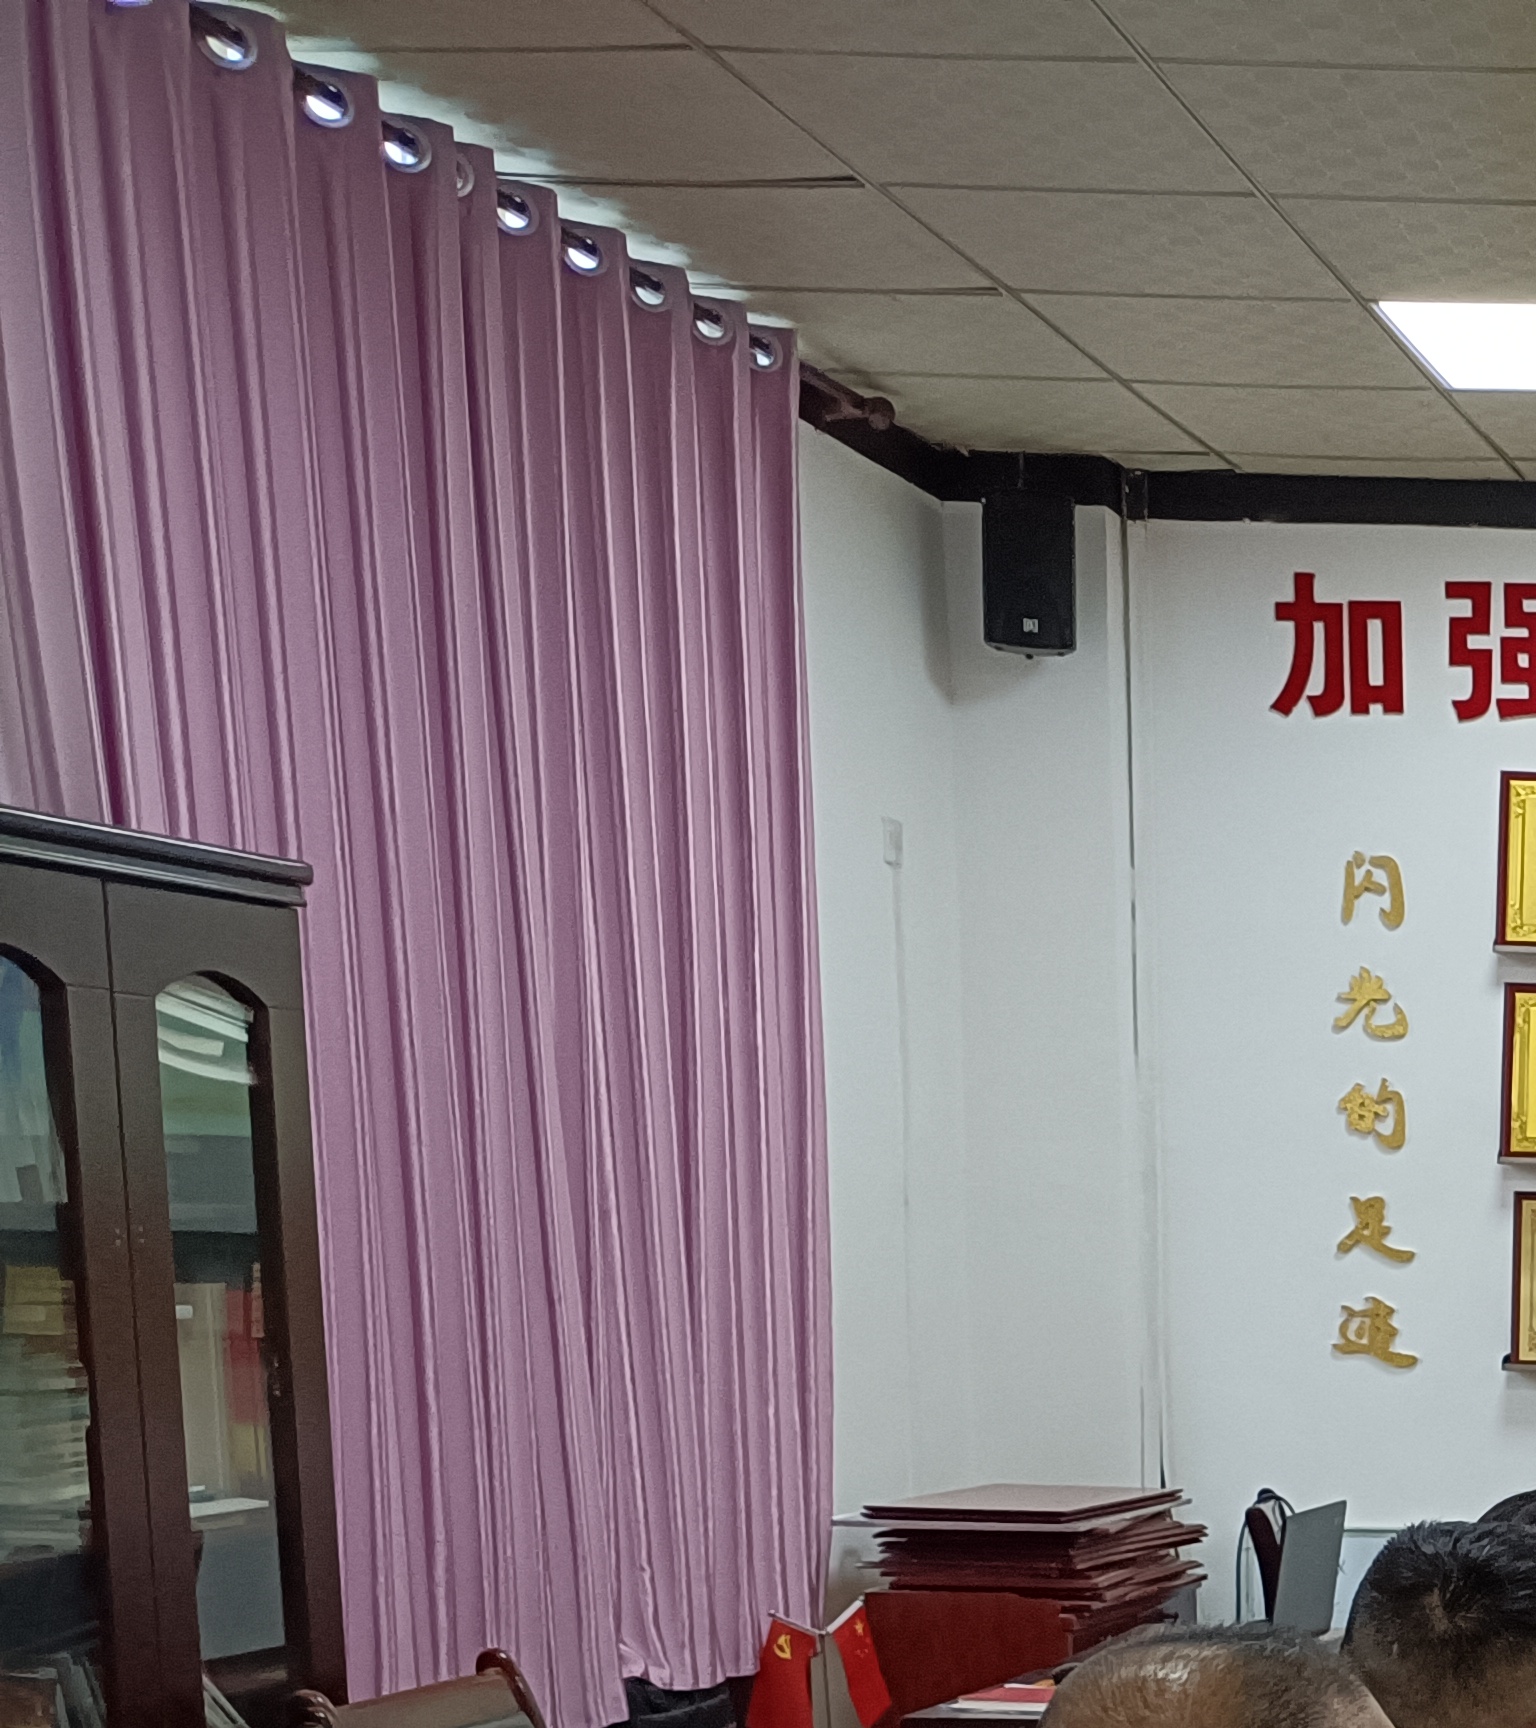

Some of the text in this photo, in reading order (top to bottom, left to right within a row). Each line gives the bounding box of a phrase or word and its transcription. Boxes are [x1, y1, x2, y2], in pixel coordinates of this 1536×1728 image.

[1333, 851, 1418, 1368] 闪光的足迹
